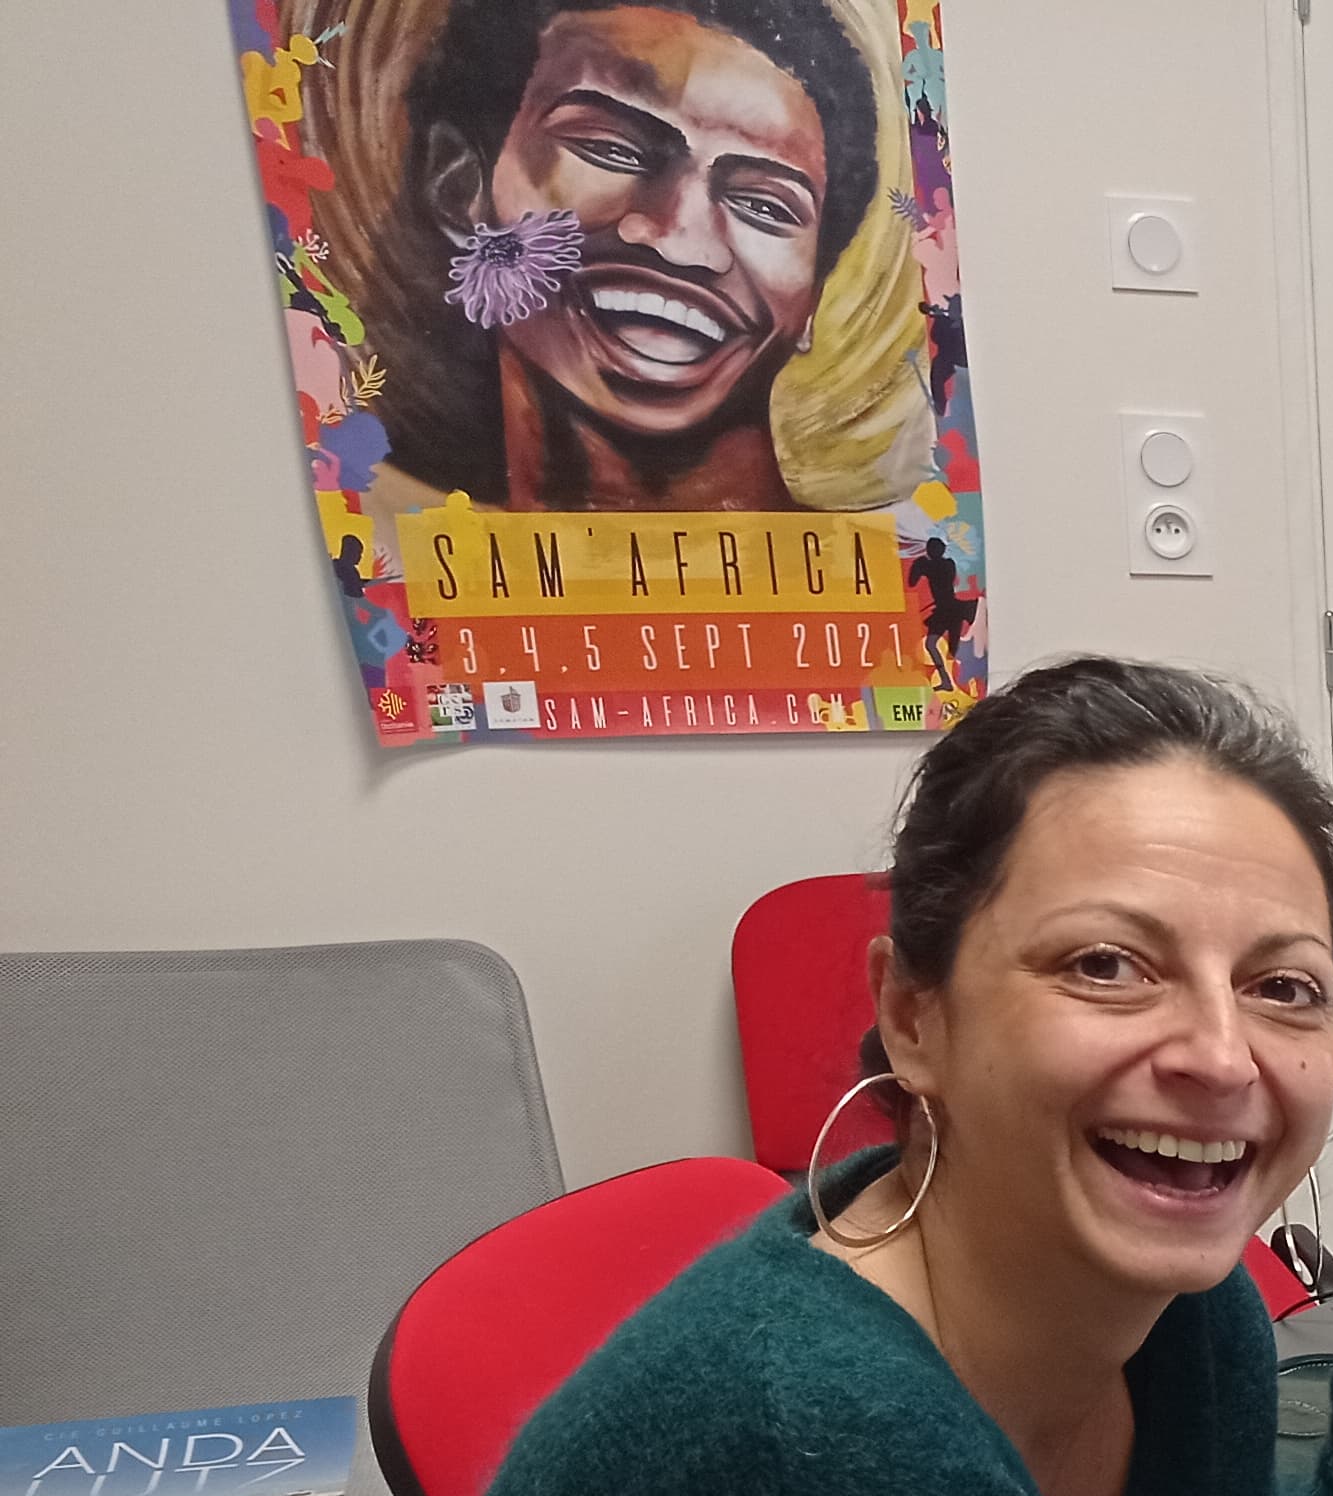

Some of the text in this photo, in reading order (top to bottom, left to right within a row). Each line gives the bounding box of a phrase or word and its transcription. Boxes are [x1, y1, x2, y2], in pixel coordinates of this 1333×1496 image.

[640, 623, 753, 671] SEPT
[793, 621, 904, 668] 2021
[893, 704, 923, 722] EMF
[31, 1426, 306, 1480] ANDA
